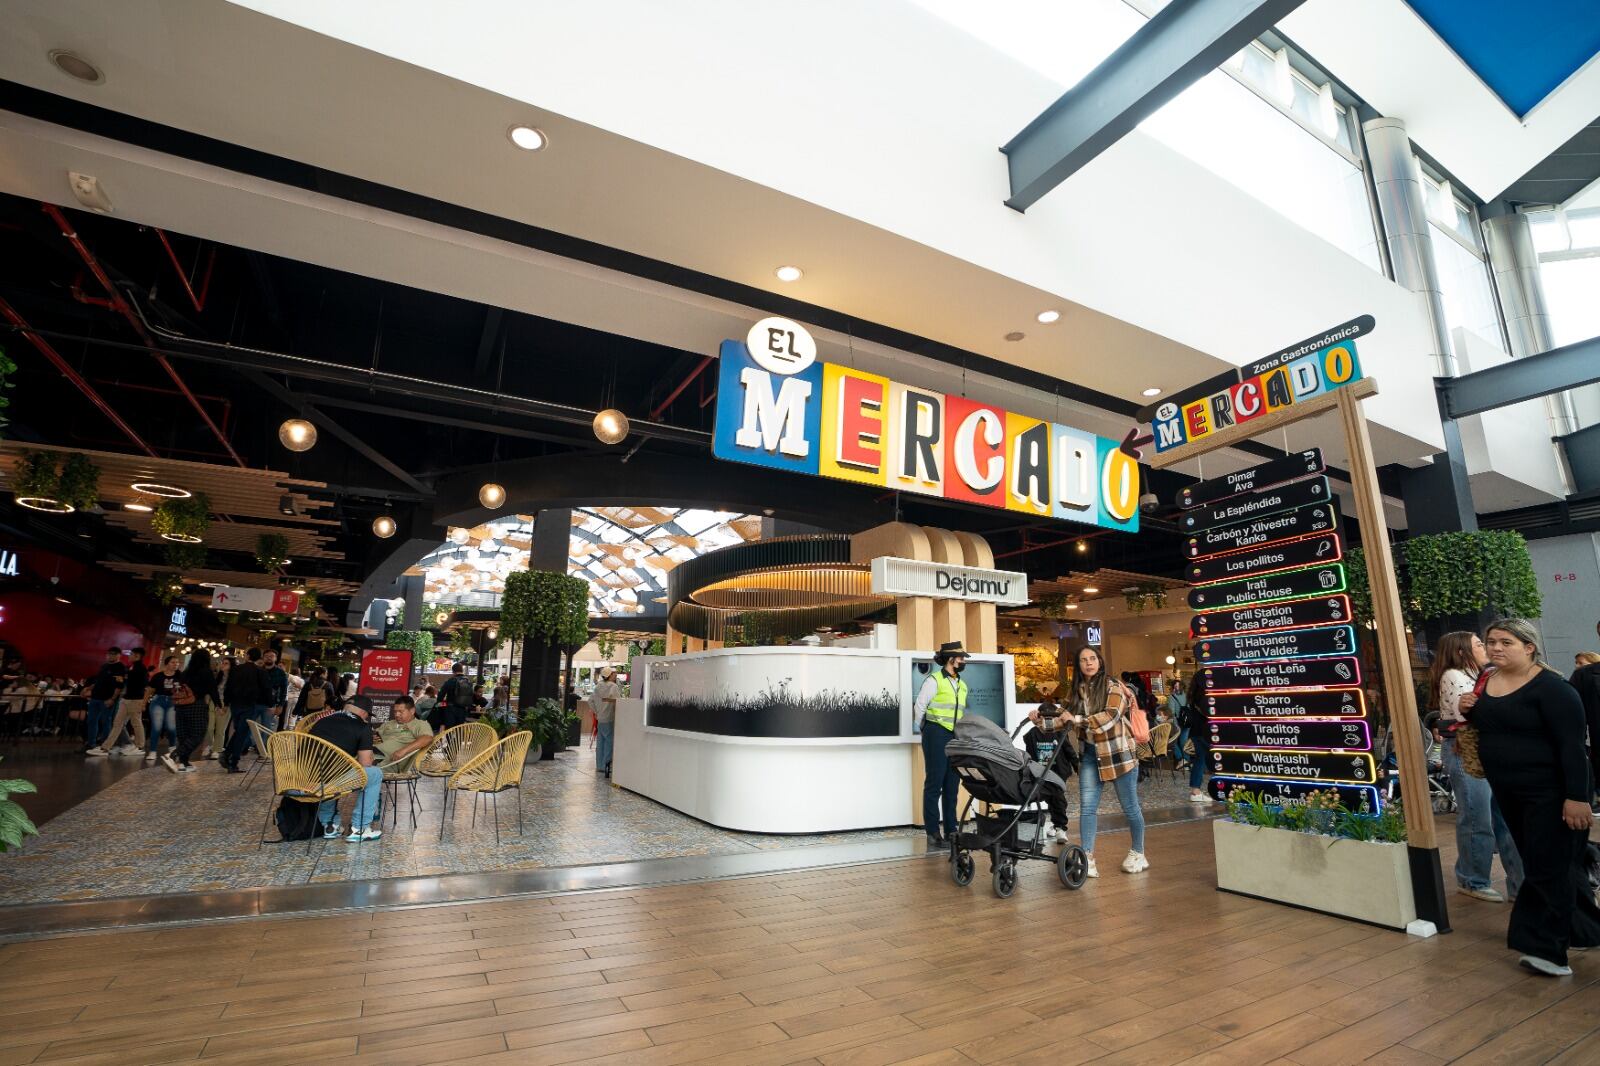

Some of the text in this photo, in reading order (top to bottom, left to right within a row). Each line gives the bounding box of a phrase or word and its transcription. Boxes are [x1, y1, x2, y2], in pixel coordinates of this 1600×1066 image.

[768, 328, 801, 358] EL
[1253, 325, 1360, 374] Zona Gastronómica
[1157, 347, 1354, 448] MERCADO
[1160, 406, 1173, 417] EL
[736, 367, 1139, 524] MERCADO
[1227, 470, 1256, 485] Dimar
[1234, 481, 1253, 492] Ava
[1214, 496, 1281, 520] La Espléndida
[1206, 529, 1241, 543] Carbón
[1242, 527, 1249, 536] y
[1236, 533, 1267, 547] Kanka
[1226, 553, 1284, 571] Los pollitos
[1247, 579, 1267, 590] Irati
[1226, 587, 1292, 603] Public House
[1233, 606, 1292, 621] Grill Station
[1234, 616, 1293, 630] Casa Paella
[1234, 635, 1296, 648] El Habanero
[1235, 646, 1299, 659] Juan Valdez
[368, 666, 403, 677] Hola!
[1233, 663, 1306, 676] Palos de Leña
[1250, 675, 1290, 686] Mr Ribs
[1254, 695, 1291, 705] Sbarro
[1243, 705, 1306, 717] La Taquería
[1252, 724, 1301, 734] Tiraditos
[1256, 735, 1298, 745] Mourad
[1252, 753, 1309, 764] Watakushi
[1243, 762, 1320, 777] Donut Factory
[1276, 784, 1291, 795] T4
